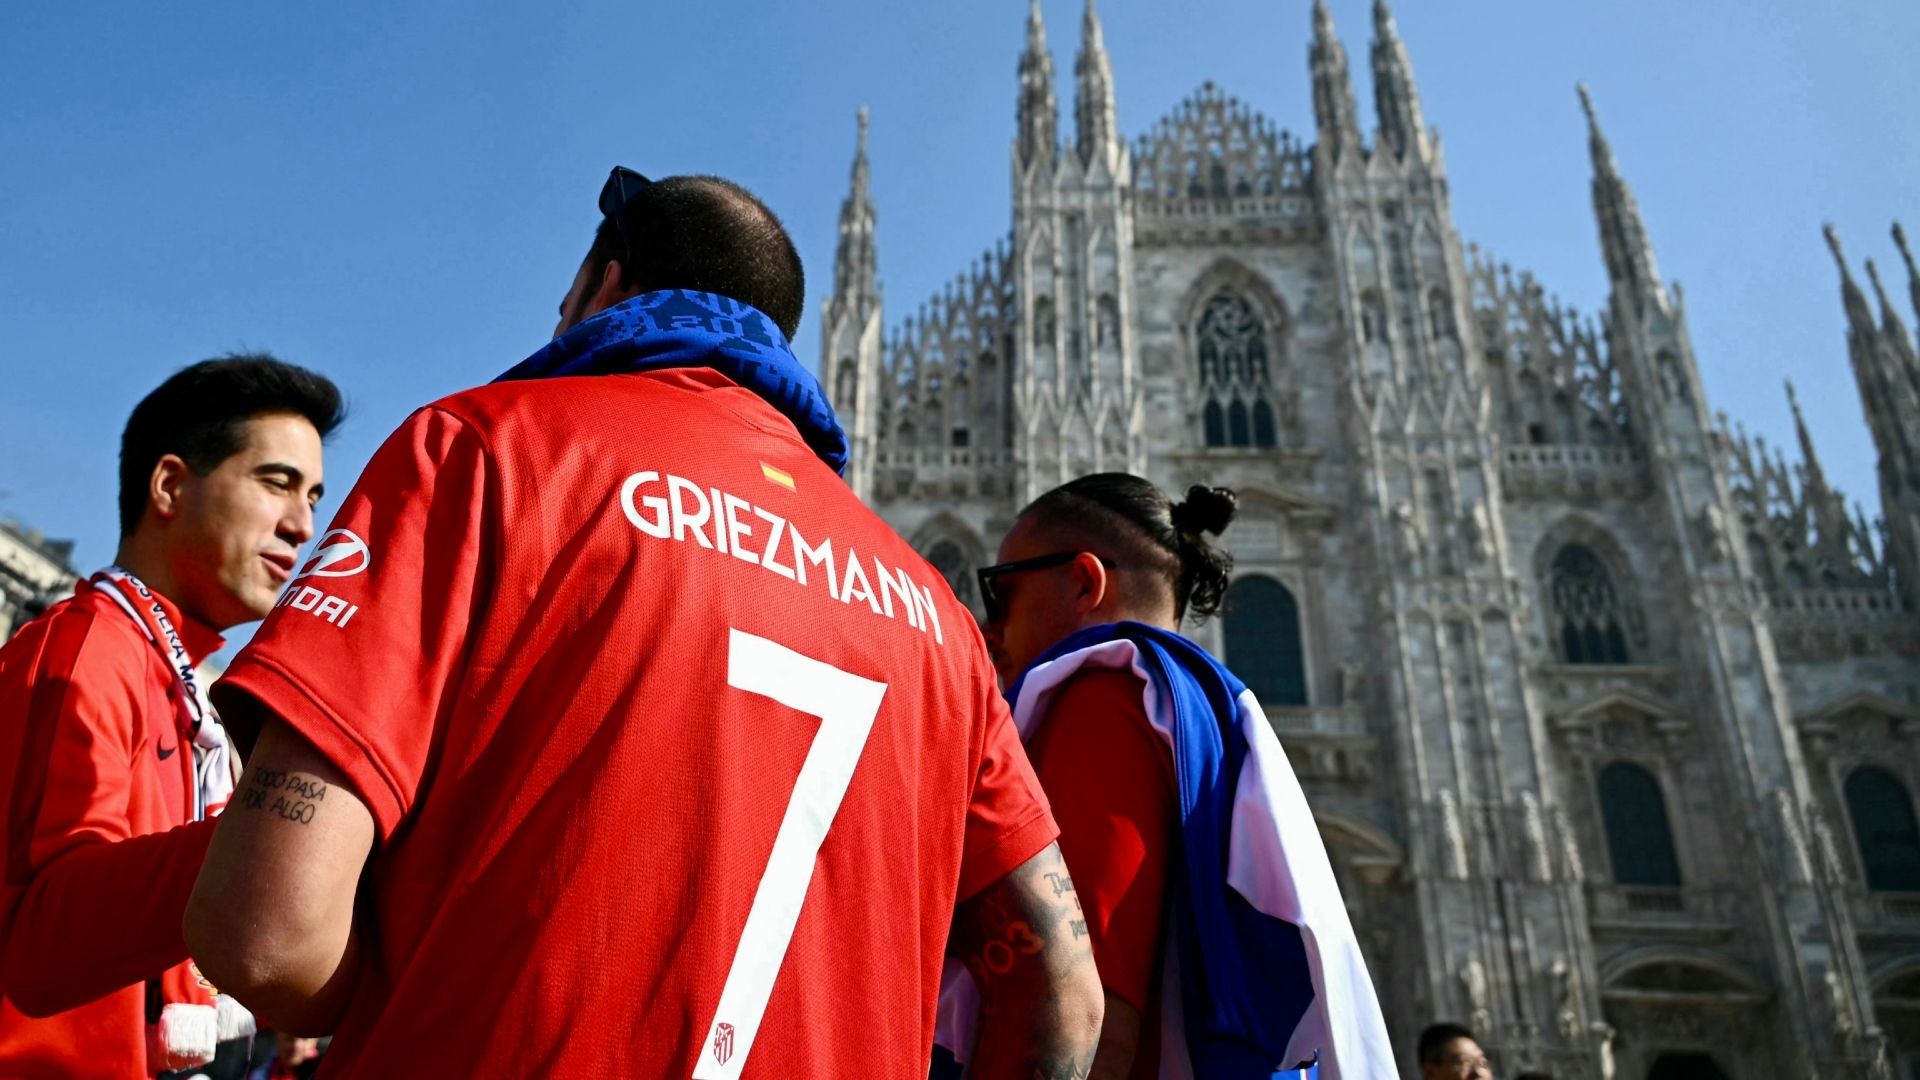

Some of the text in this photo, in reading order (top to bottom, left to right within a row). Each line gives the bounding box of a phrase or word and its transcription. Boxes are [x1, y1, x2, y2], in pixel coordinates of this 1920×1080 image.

[620, 471, 943, 645] GRIEZMANN
[270, 796, 315, 824] ALGO
[287, 776, 327, 801] PASA
[692, 627, 888, 1080] 7
